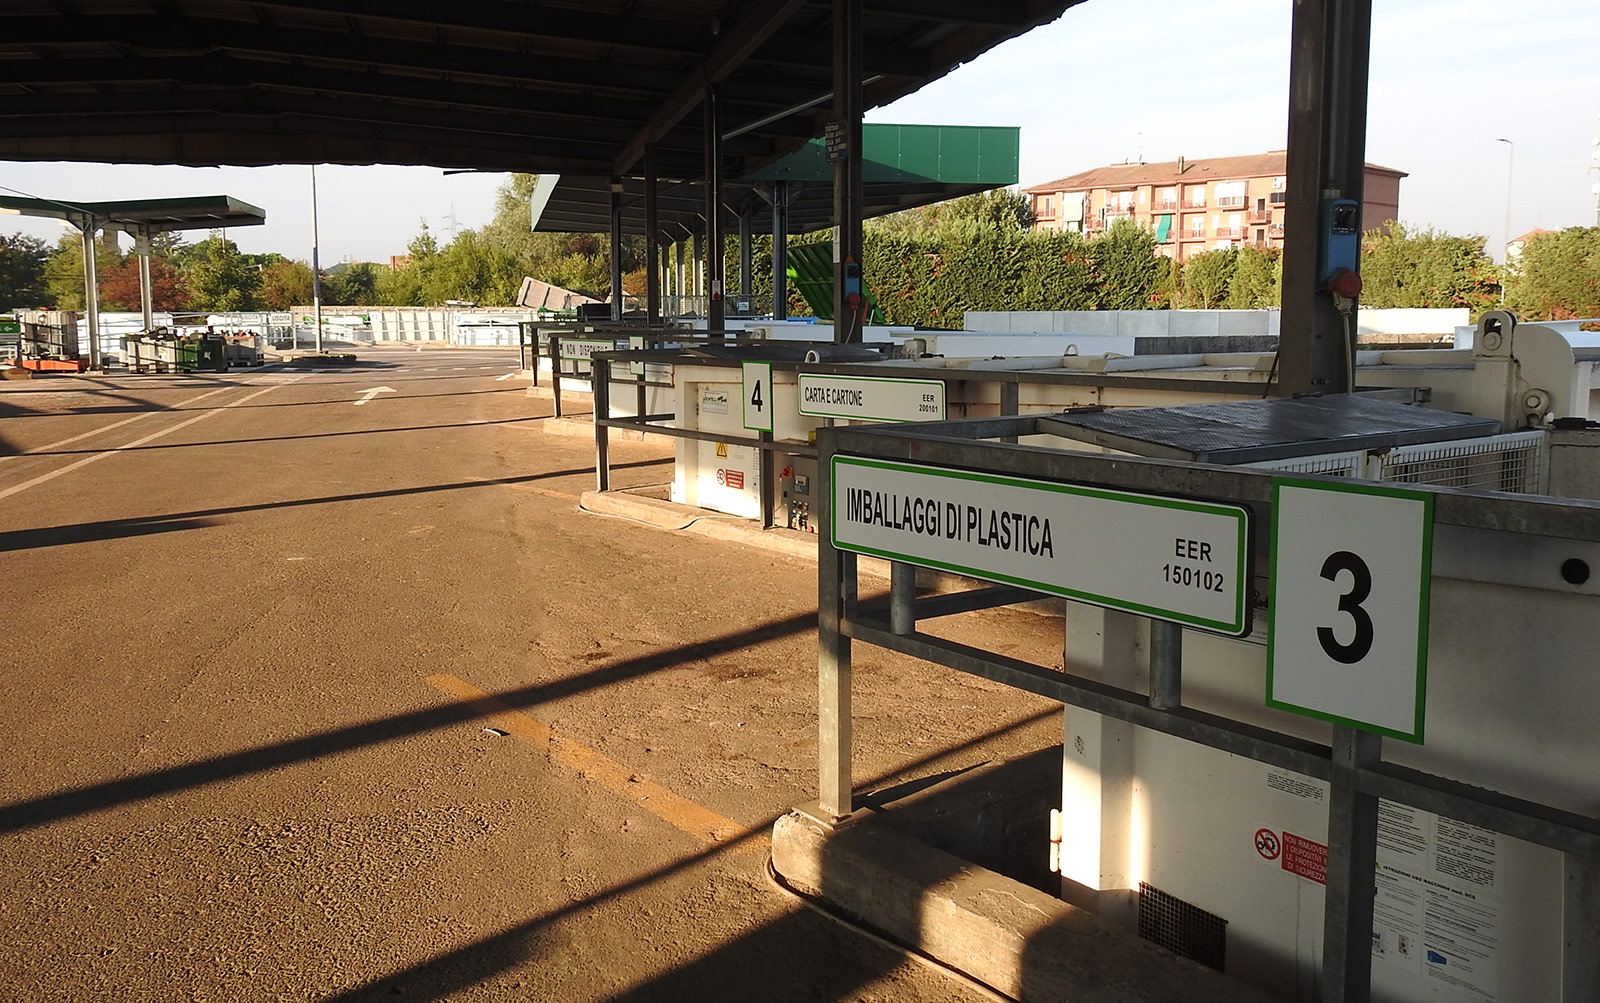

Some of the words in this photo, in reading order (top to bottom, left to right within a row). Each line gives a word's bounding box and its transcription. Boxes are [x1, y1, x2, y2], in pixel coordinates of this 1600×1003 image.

[566, 344, 576, 355] NON
[751, 380, 763, 412] 4
[804, 386, 826, 403] CARTA
[826, 388, 831, 404] E
[832, 388, 863, 407] CARTONE
[922, 394, 935, 402] EER
[919, 404, 938, 413] 200101
[846, 487, 941, 538] IMBALLAGGI
[946, 502, 962, 542] DI
[967, 506, 1054, 559] PLASTICA
[1175, 538, 1212, 563] EER
[1162, 564, 1224, 593] 150102
[1317, 551, 1372, 663] 3
[1284, 834, 1297, 845] NON
[1298, 839, 1328, 856] RIMUOVER
[1290, 846, 1322, 862] DISPOSITIVI
[1286, 853, 1294, 861] LE
[1295, 856, 1328, 873] PROTEZION
[1287, 861, 1294, 870] DI
[1295, 864, 1326, 881] SICUREZZA
[1383, 865, 1411, 878] ISTRUZIONI
[1423, 878, 1450, 891] MACCHINA
